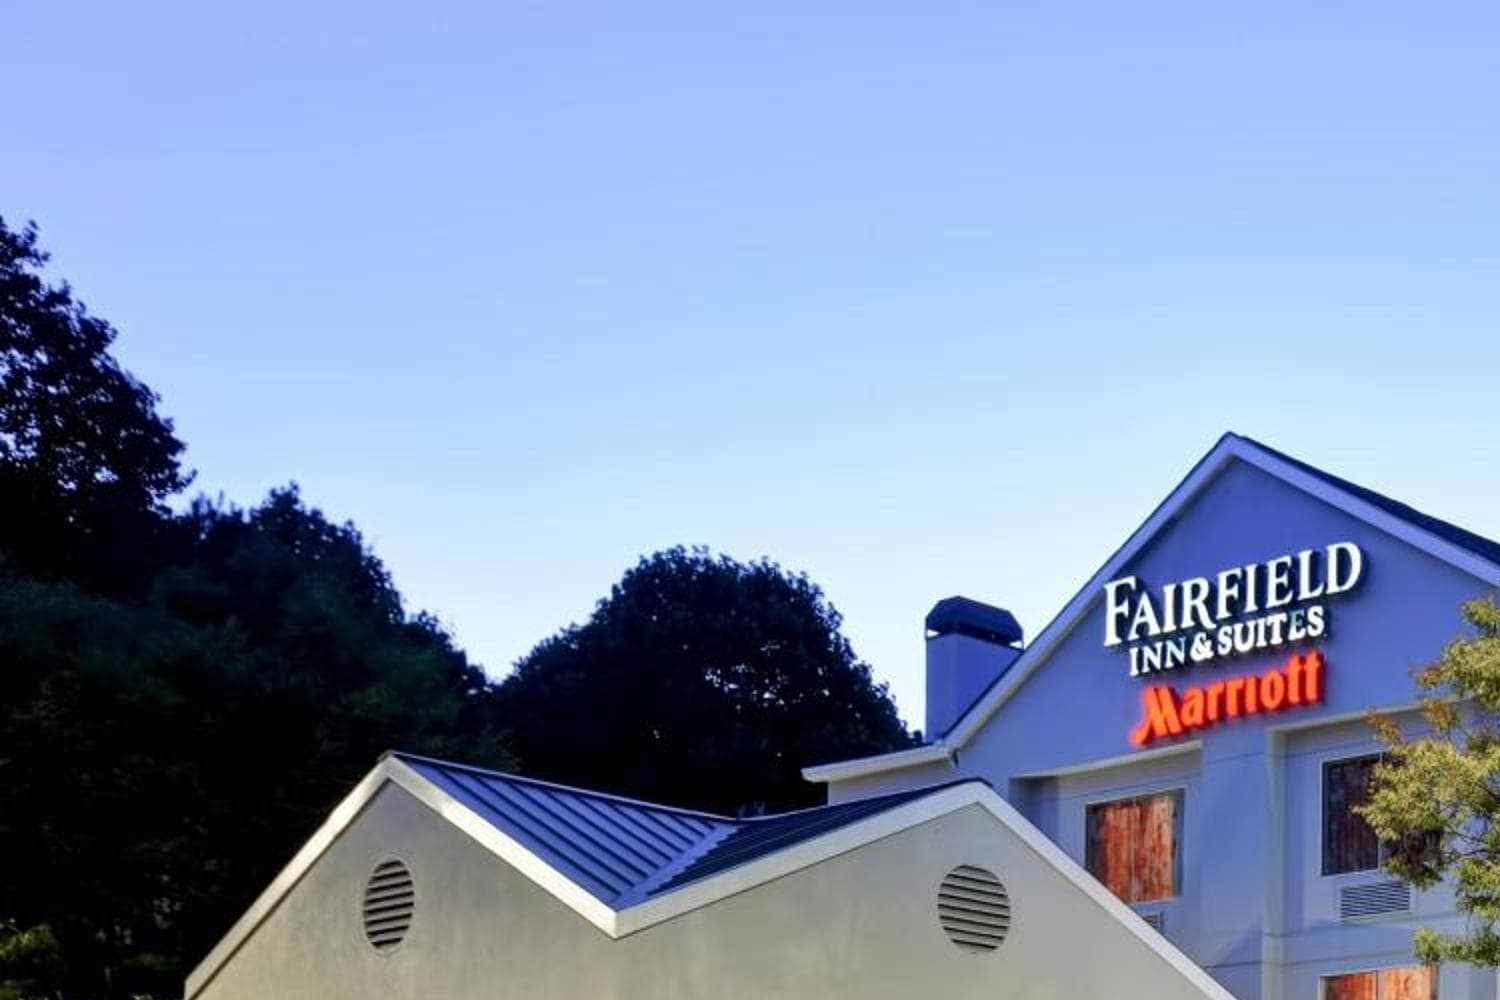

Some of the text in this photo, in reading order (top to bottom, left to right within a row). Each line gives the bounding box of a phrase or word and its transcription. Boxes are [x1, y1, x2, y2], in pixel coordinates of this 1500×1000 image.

[1103, 541, 1362, 647] FAIRFIELD
[1129, 636, 1186, 676] INN
[1217, 605, 1325, 656] SUITES
[1129, 650, 1322, 747] Marriott
